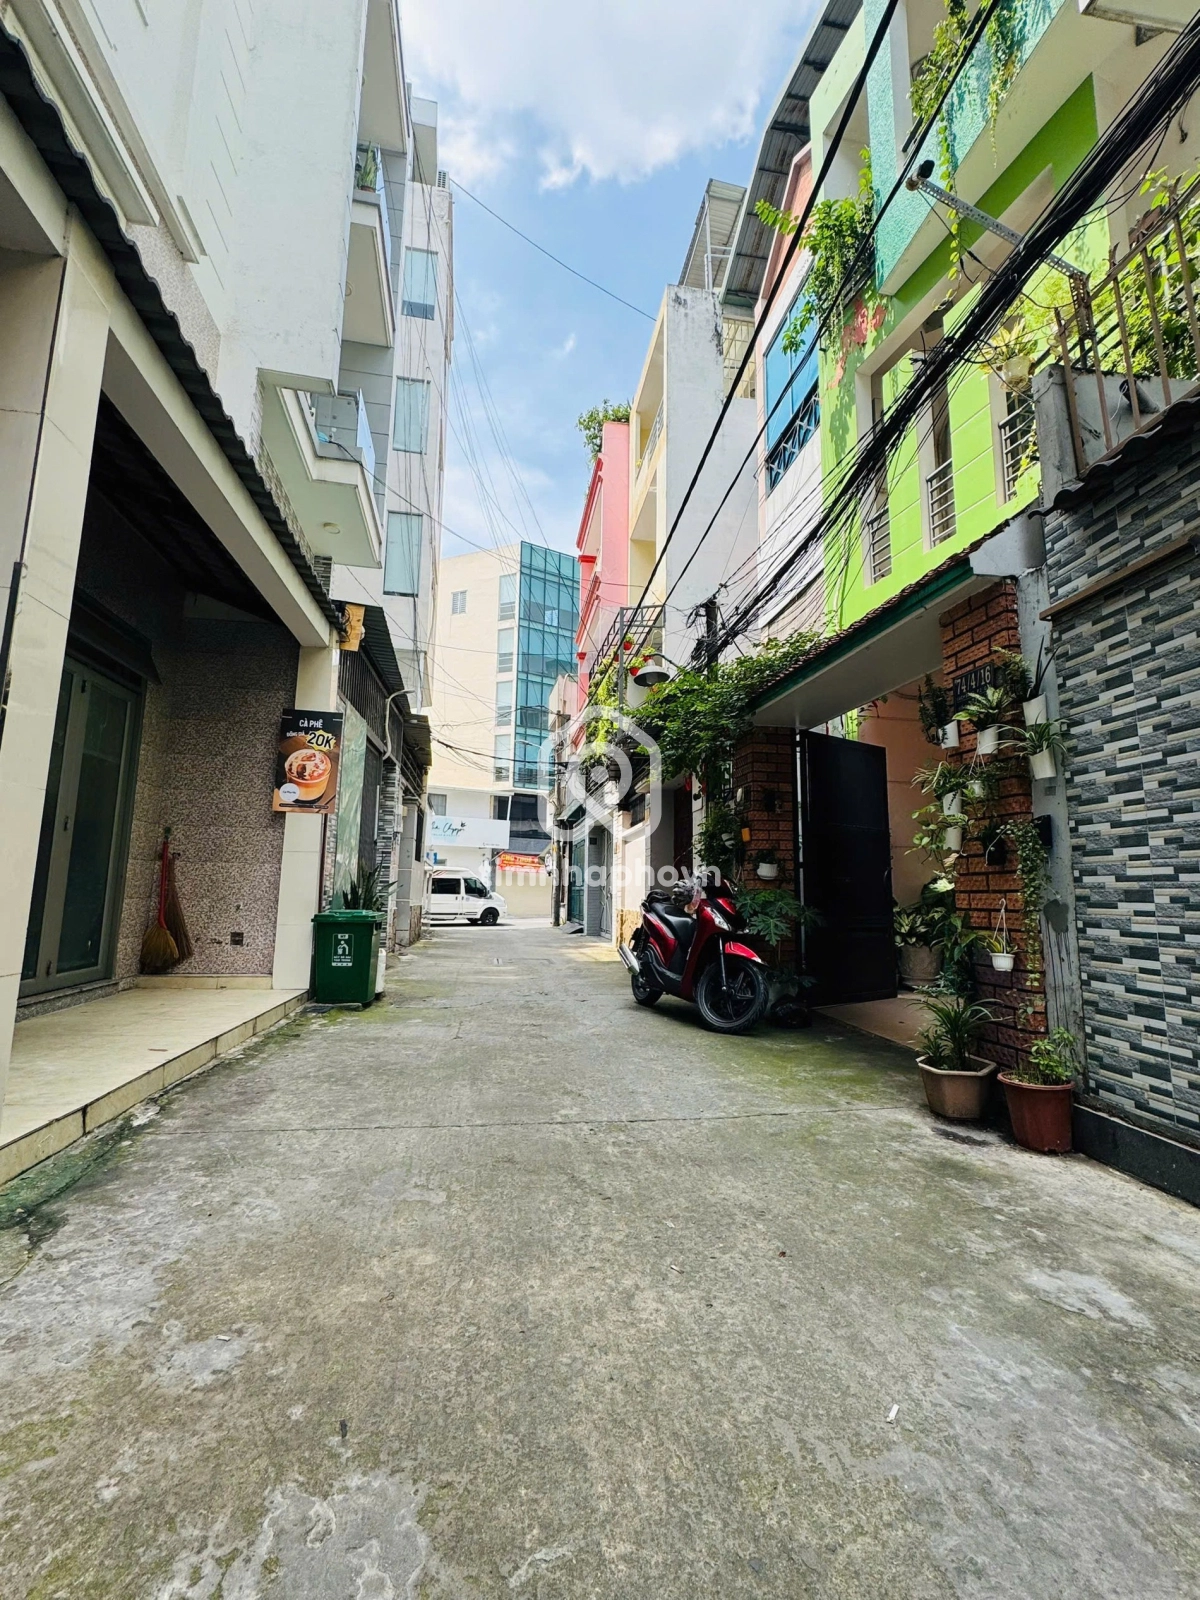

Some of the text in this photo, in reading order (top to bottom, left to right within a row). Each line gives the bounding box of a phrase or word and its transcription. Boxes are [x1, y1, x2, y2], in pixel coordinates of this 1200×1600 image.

[954, 666, 990, 694] 74/4/16
[299, 717, 323, 728] CÀ PHÊ
[306, 732, 334, 749] 20K
